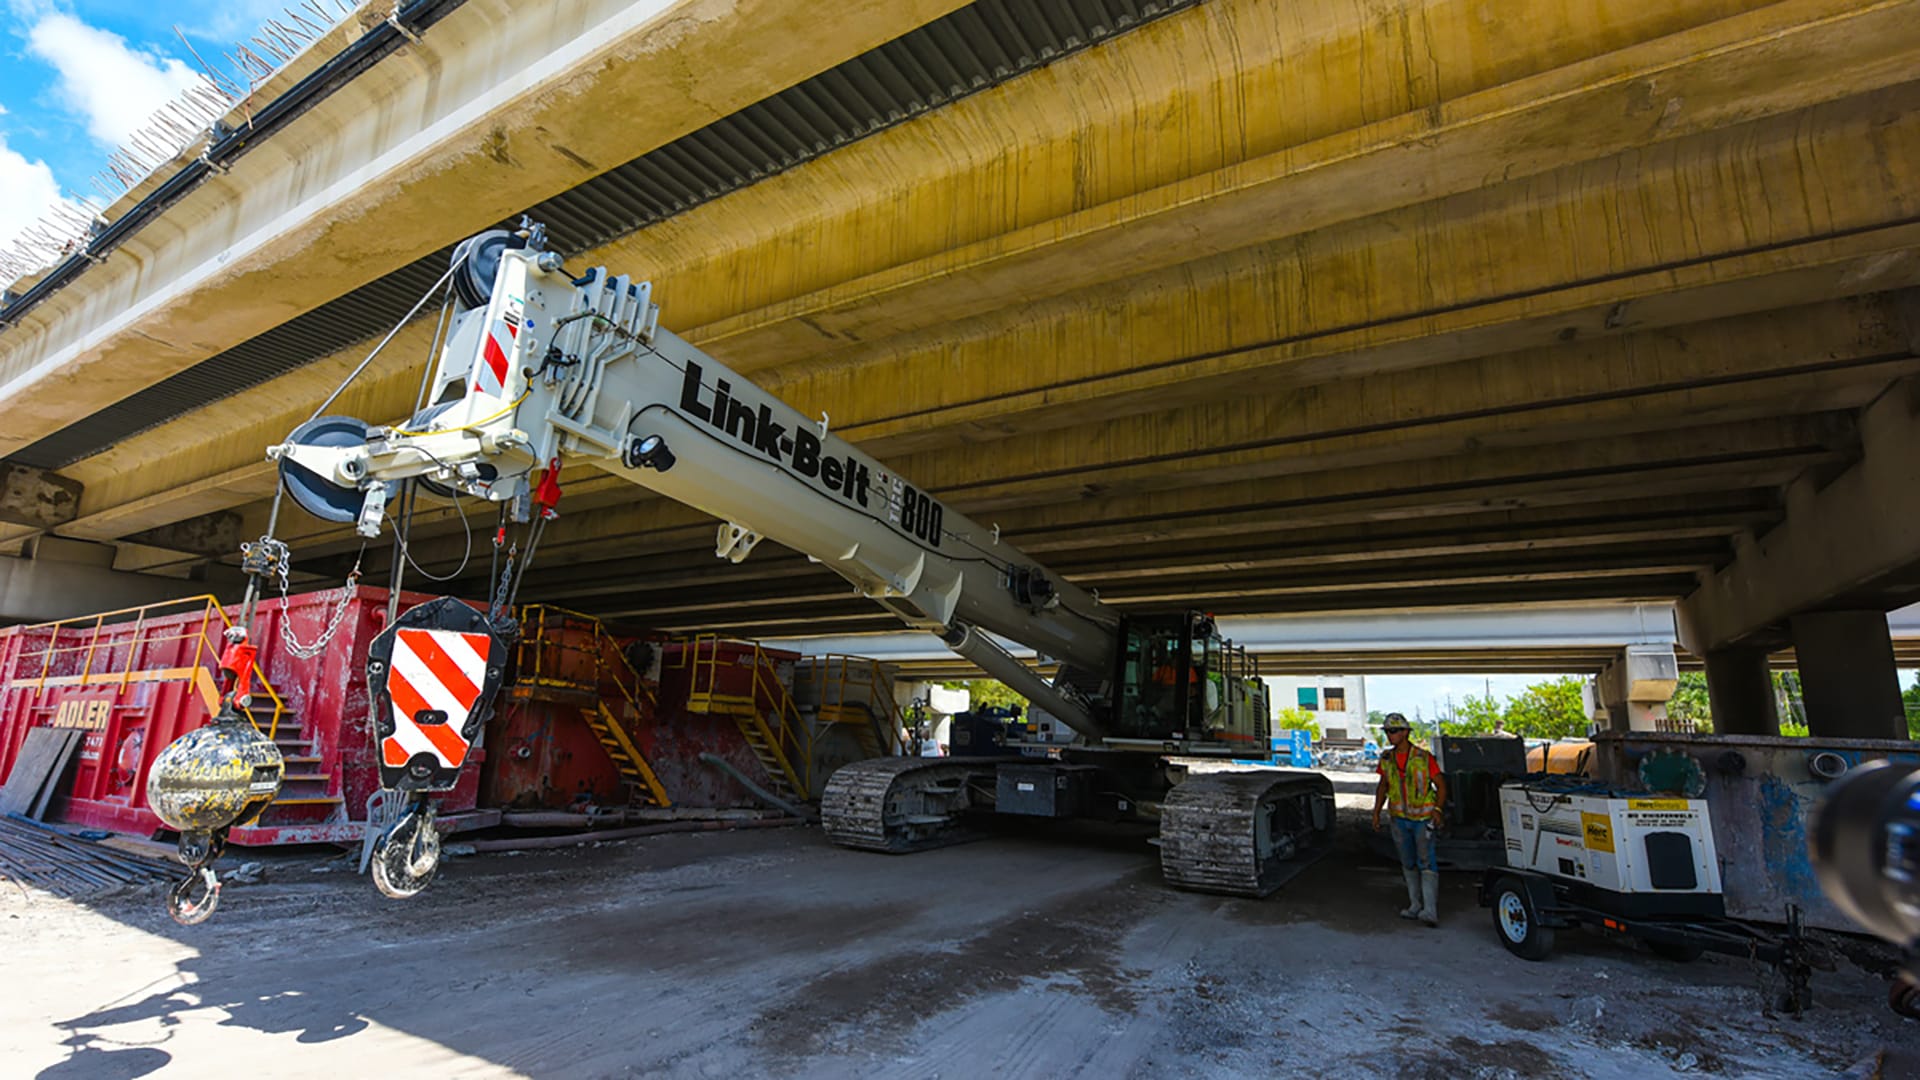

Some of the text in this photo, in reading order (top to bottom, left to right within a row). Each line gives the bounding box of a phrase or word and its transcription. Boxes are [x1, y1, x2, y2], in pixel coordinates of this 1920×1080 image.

[680, 360, 870, 508] Link-Belt
[901, 485, 943, 547] 800
[54, 700, 109, 729] ADLER
